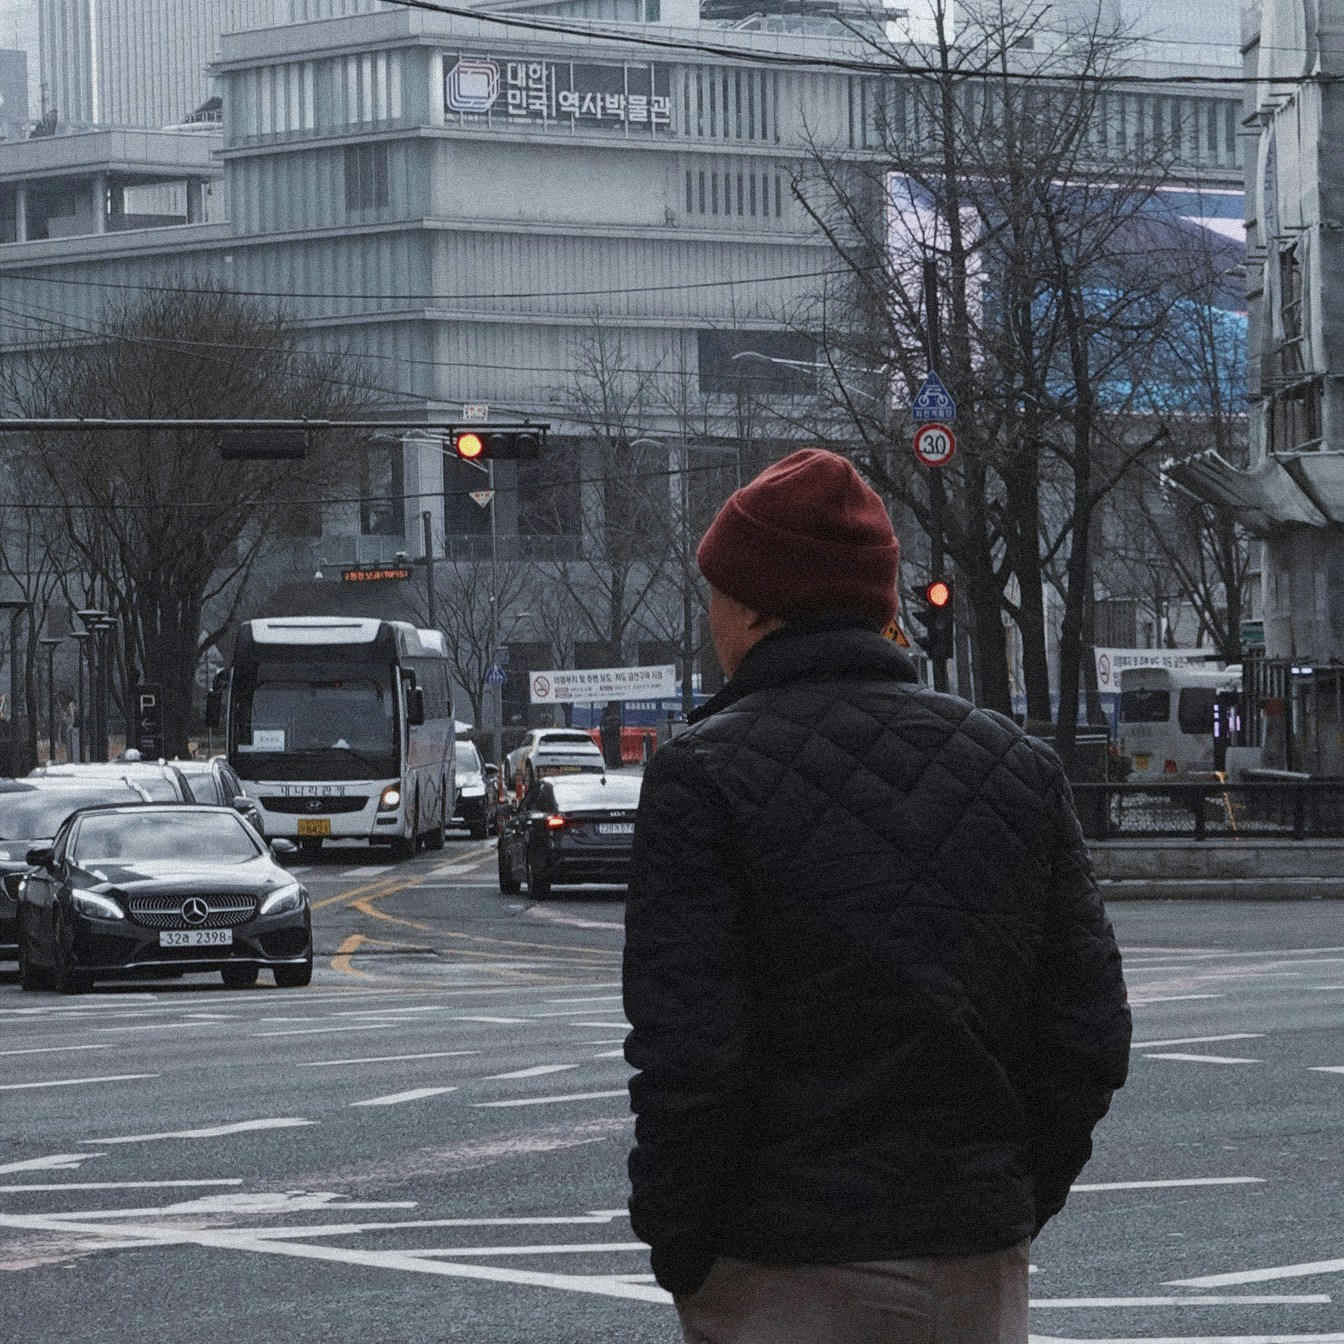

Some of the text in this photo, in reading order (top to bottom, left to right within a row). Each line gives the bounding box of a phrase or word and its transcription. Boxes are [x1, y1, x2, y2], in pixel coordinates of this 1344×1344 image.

[507, 62, 548, 88] 대한
[508, 89, 548, 115] 민국
[559, 90, 671, 123] 역사박물관
[923, 435, 947, 454] 30
[196, 930, 226, 944] 2398
